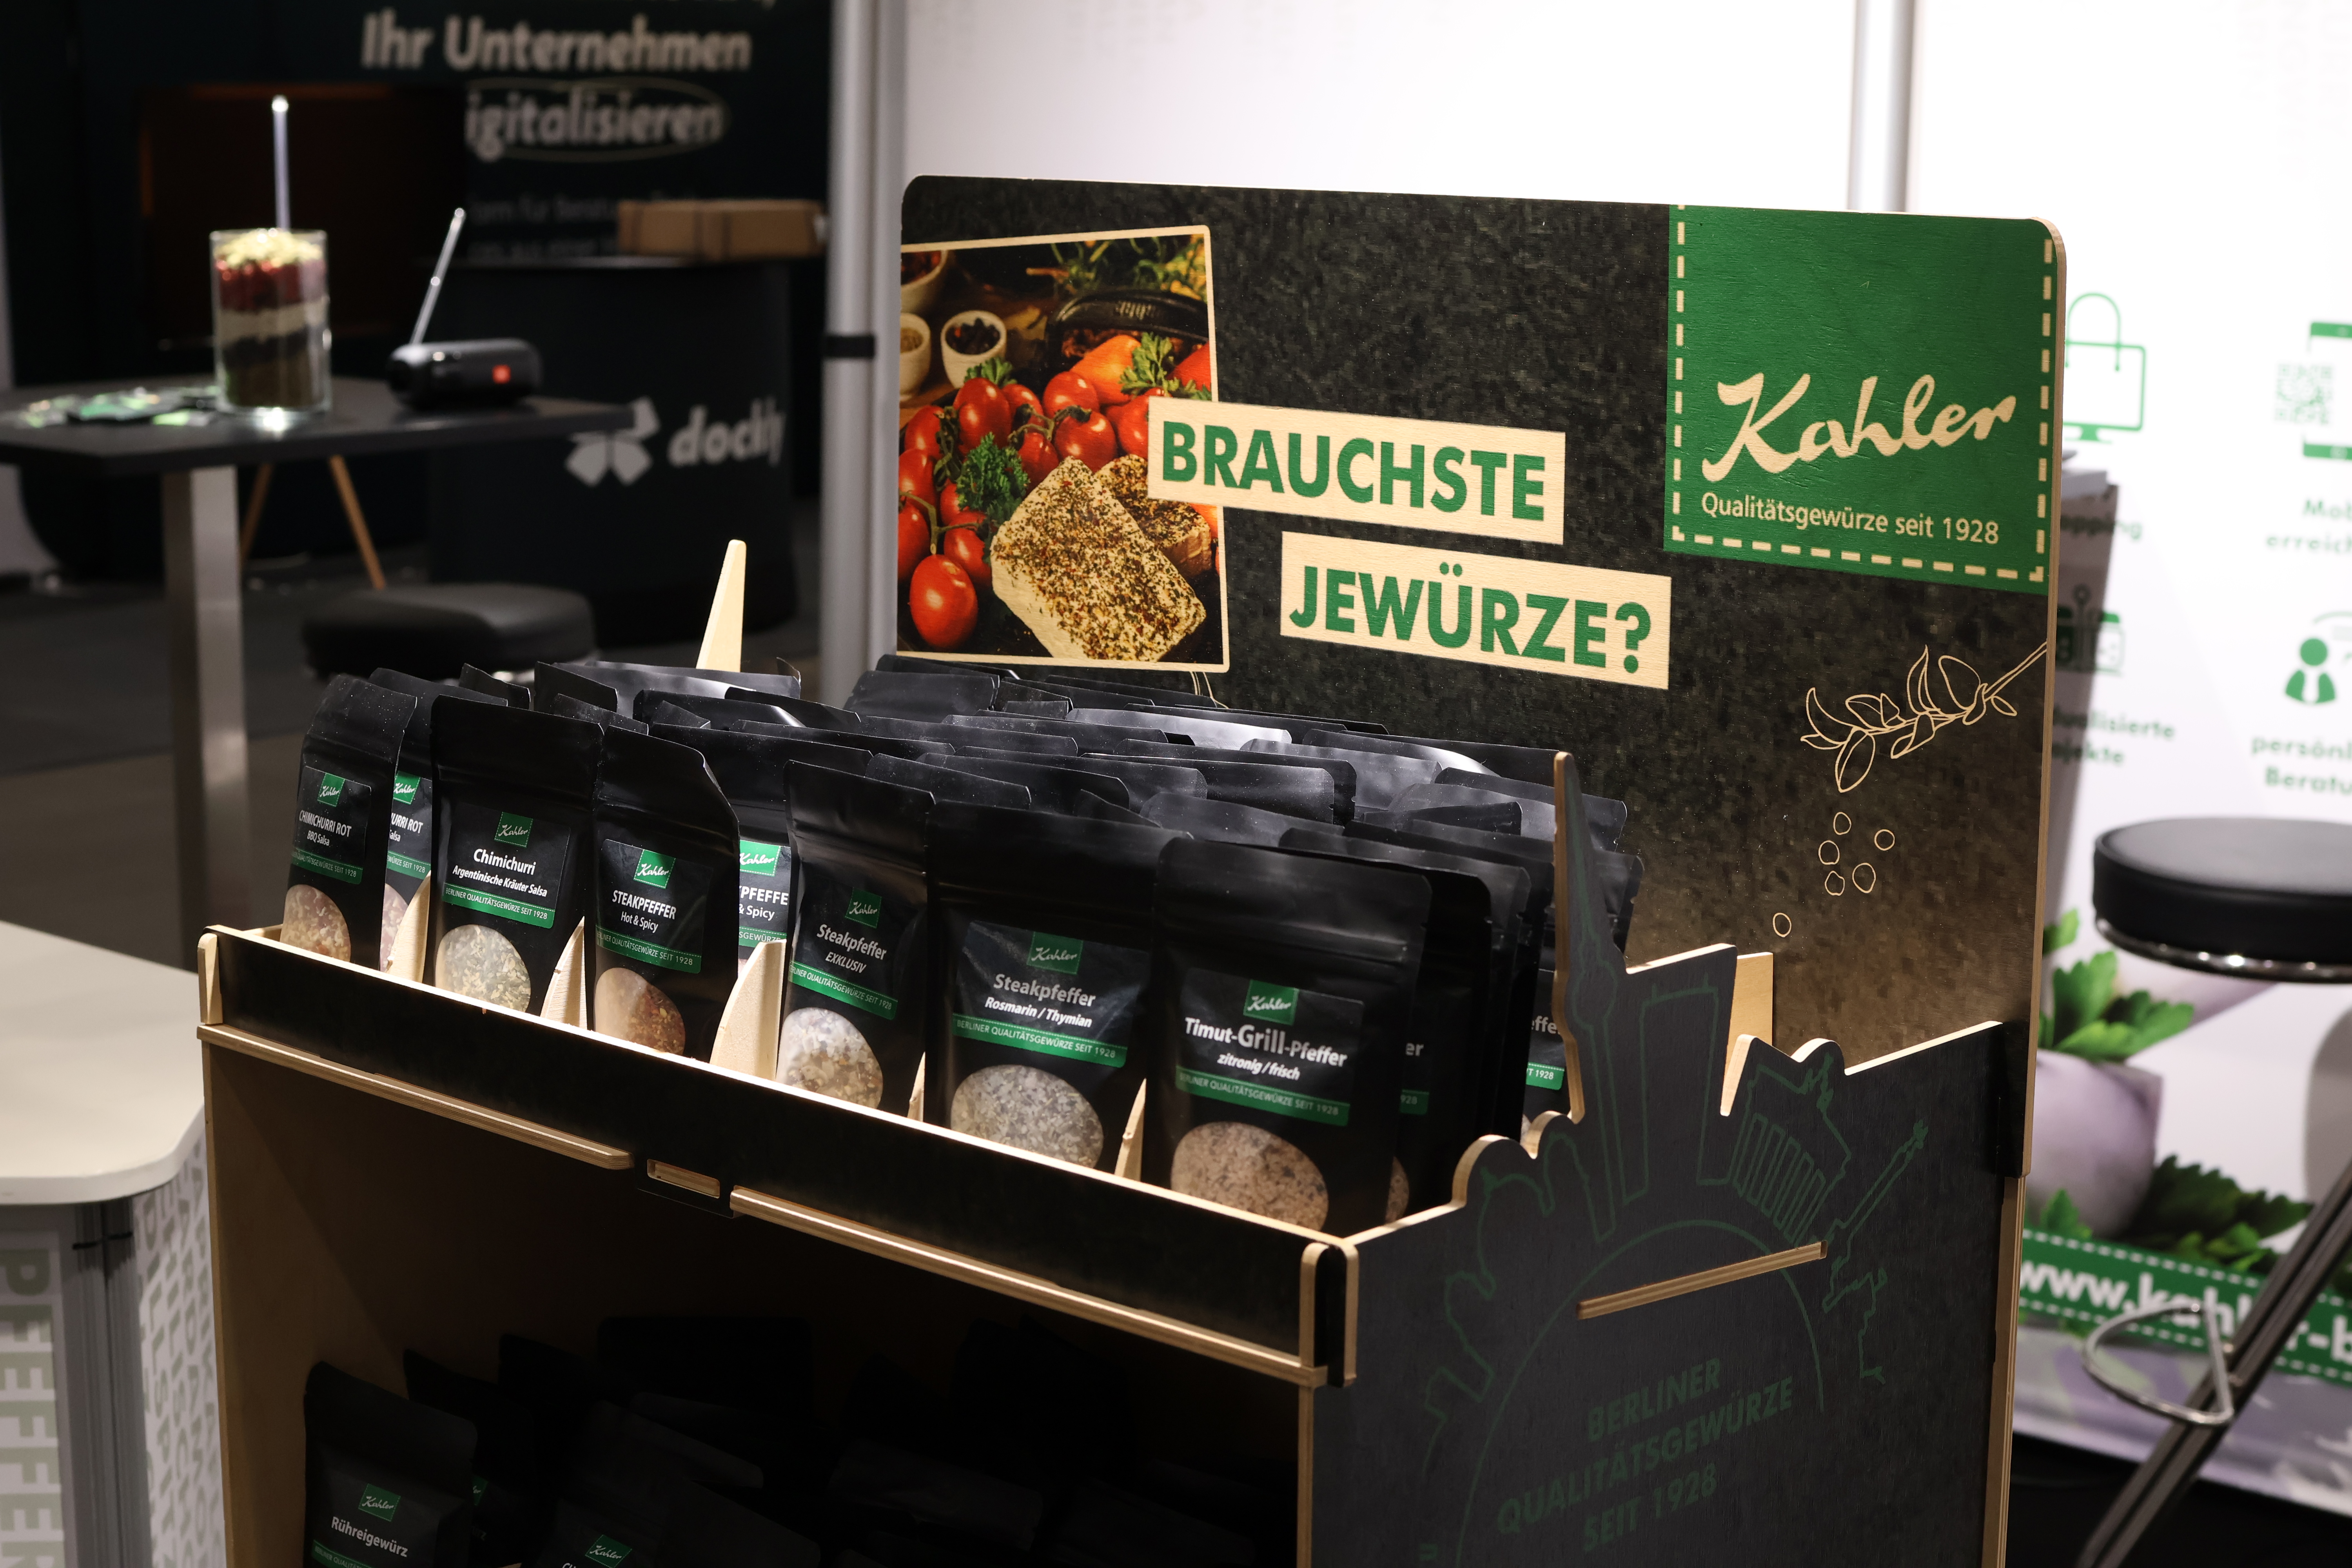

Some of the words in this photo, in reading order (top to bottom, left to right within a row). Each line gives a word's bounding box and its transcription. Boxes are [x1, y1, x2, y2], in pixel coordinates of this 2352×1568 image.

[361, 8, 432, 69] Ihr
[445, 13, 752, 71] Unternehmen
[1701, 372, 2016, 482] Kahler
[1162, 420, 1545, 522] BRAUCHSTE
[1701, 492, 1889, 532] Qualitätsgewürze
[1895, 516, 1934, 538] seit
[1944, 517, 1999, 545] 1928
[1290, 561, 1651, 674] JEWÜRZE?
[320, 785, 340, 797] Kahler
[394, 782, 415, 794] Kahler
[299, 810, 336, 833] CHIMICHURRI
[336, 822, 352, 837] ROT
[407, 819, 423, 834] ROT
[498, 824, 528, 837] Kahler
[307, 830, 317, 843] BBQ
[317, 833, 330, 846] Salsa
[334, 866, 344, 874] SEIT
[345, 869, 356, 877] 1928
[414, 864, 426, 873] 1928
[473, 848, 536, 875] Chimichurri
[637, 864, 669, 877] Kahler
[740, 853, 775, 865] Kahler
[452, 865, 503, 886] Argentinische
[503, 877, 528, 892] Kräuter
[528, 884, 548, 897] Salsa
[446, 887, 466, 899] BERLINER
[467, 893, 520, 913] QUALITÄTSGEWÜRZE
[521, 906, 532, 916] SEIT
[533, 910, 548, 919] 1928
[612, 890, 677, 920] STEAKPFEFFER
[739, 886, 789, 906] PFEFFE
[849, 901, 878, 915] Kahler
[621, 911, 633, 924] Hot
[633, 916, 639, 926] &
[639, 917, 659, 933] Spicy
[746, 905, 775, 921] Spicy
[612, 936, 659, 957] QUALITÄTSGEWÜRZE
[660, 952, 673, 961] SEIT
[675, 956, 693, 965] 1928
[817, 924, 887, 960] Steakpfeffer
[1031, 947, 1078, 962] Kahler
[825, 951, 867, 974] EXKLUSIV
[807, 973, 865, 1000] QUALITÄTSGEWÜRZE
[865, 994, 878, 1005] SEIT
[879, 999, 892, 1010] 1928
[993, 973, 1096, 1007] Steakpfeffer
[1247, 995, 1291, 1011] Kahler
[984, 996, 1036, 1018] Rosmarin
[1046, 1008, 1093, 1028] Thymian
[957, 1020, 990, 1033] BERLINER
[991, 1026, 1073, 1051] QUALITÄTSGEWÜRZE
[1074, 1043, 1093, 1053] SEIT
[1095, 1047, 1116, 1058] 1928
[1184, 1016, 1348, 1067] Timut-Grill-Pfeffer
[1535, 1069, 1554, 1080] 1928
[1210, 1081, 1293, 1107] QUALITÄTSGEWÜRZE
[1295, 1099, 1314, 1110] SEIT
[1317, 1104, 1339, 1116] 1928
[1586, 1357, 1721, 1443] BERLINER
[1497, 1376, 1794, 1534] QUALITÄTSGEWÜRZE
[362, 1496, 394, 1510] Kahler
[1583, 1495, 1641, 1553] SEIT
[1654, 1463, 1718, 1519] 1928
[331, 1516, 408, 1558] Rühreigewürz
[590, 1545, 622, 1559] Kahler
